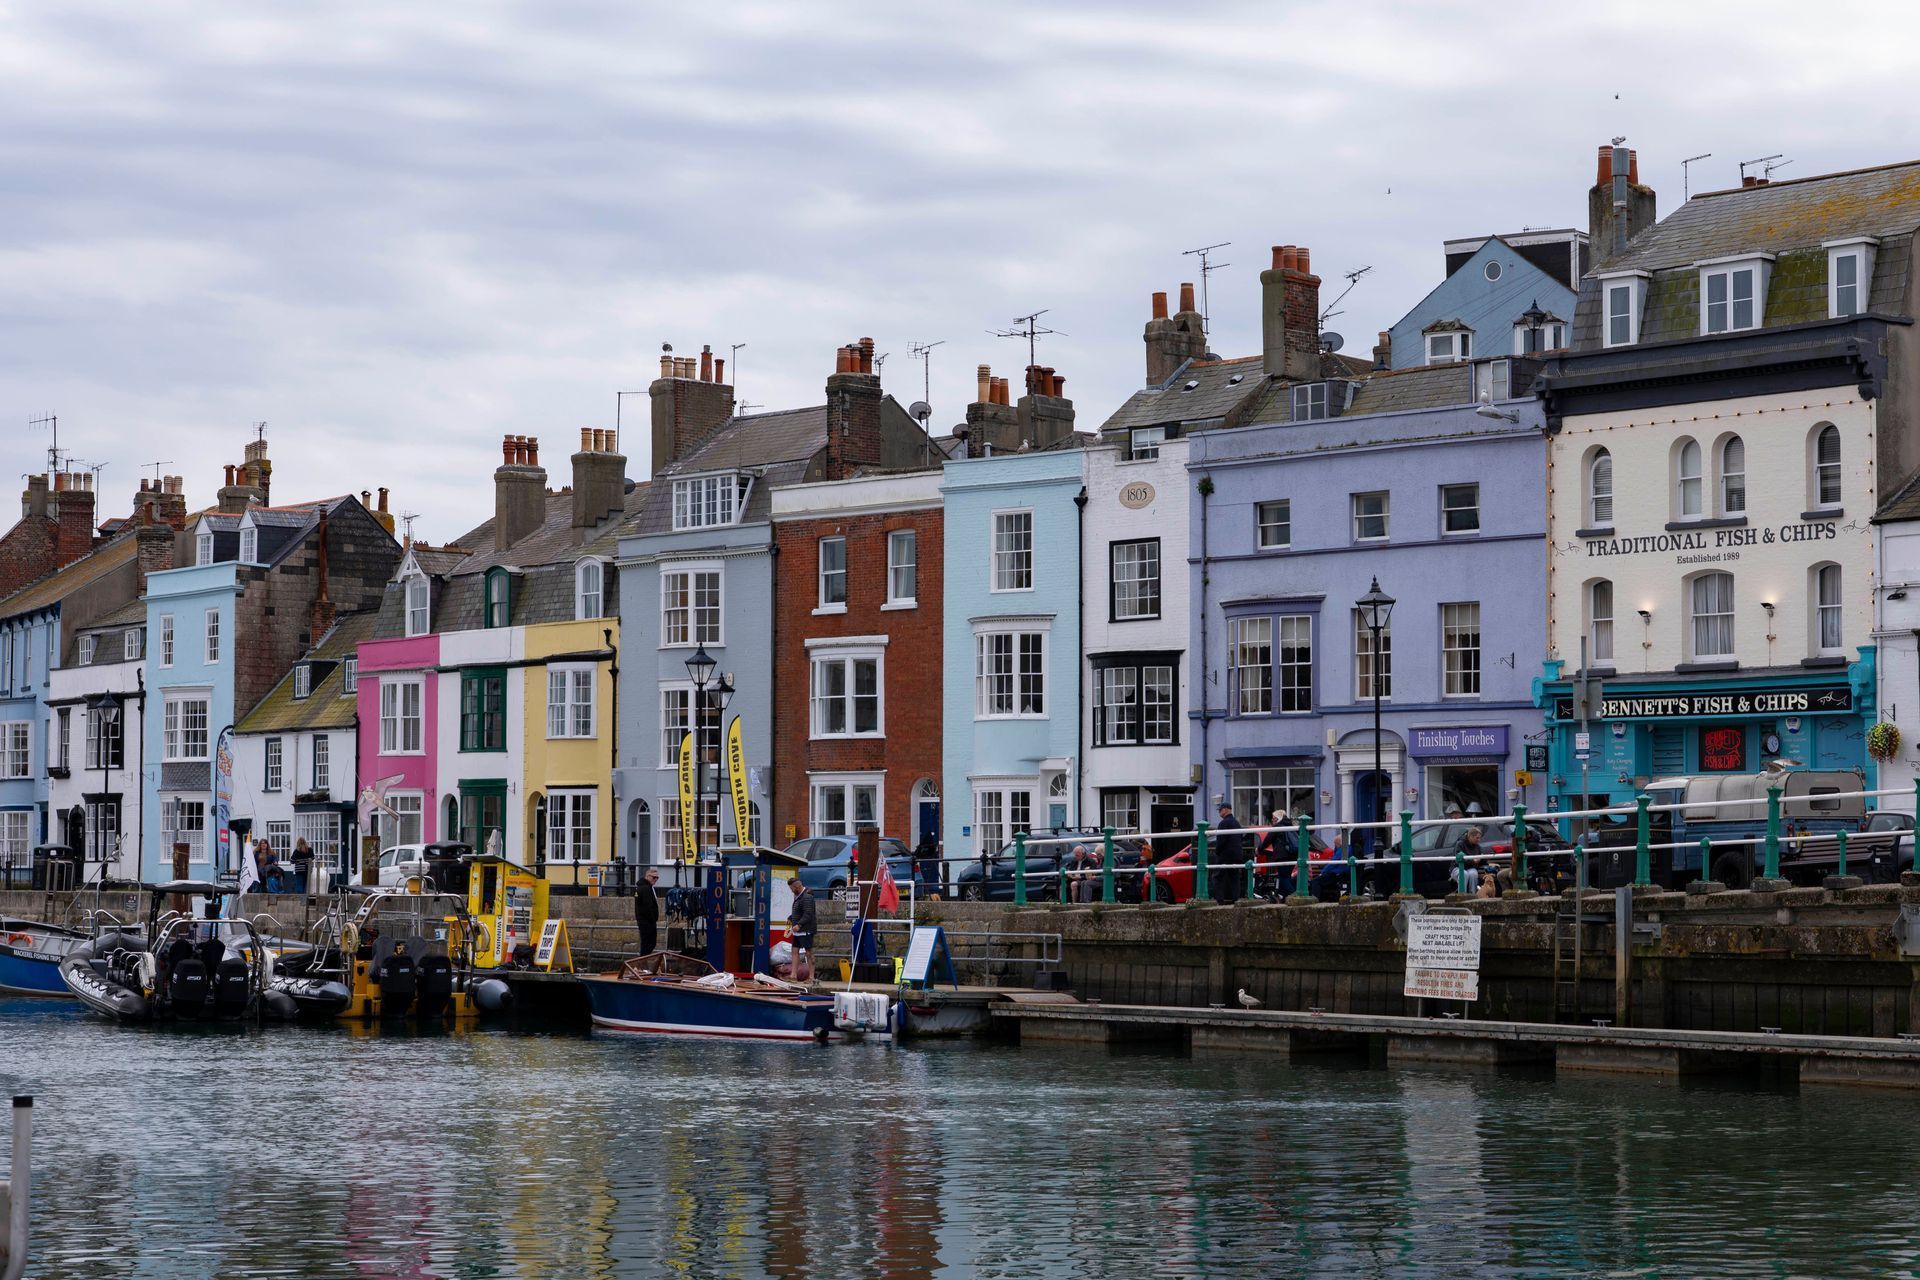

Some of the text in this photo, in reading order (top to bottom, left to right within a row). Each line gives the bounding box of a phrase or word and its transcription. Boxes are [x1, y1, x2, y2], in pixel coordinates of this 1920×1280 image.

[1127, 488, 1148, 501] 1805
[1586, 522, 1836, 557] TRADITIONAL FISH & CHIPS
[1677, 552, 1740, 564] Established 1989
[1601, 693, 1808, 717] BENNETT'S FISH & CHIPS
[1418, 730, 1495, 750] Finishing Touches
[730, 737, 741, 772] COVE
[714, 871, 723, 930] BOAT
[758, 870, 766, 946] RIDES
[543, 923, 558, 936] BOAT
[541, 937, 554, 948] TRIPS
[13, 949, 33, 959] MACKEREL
[33, 952, 49, 961] FISHING
